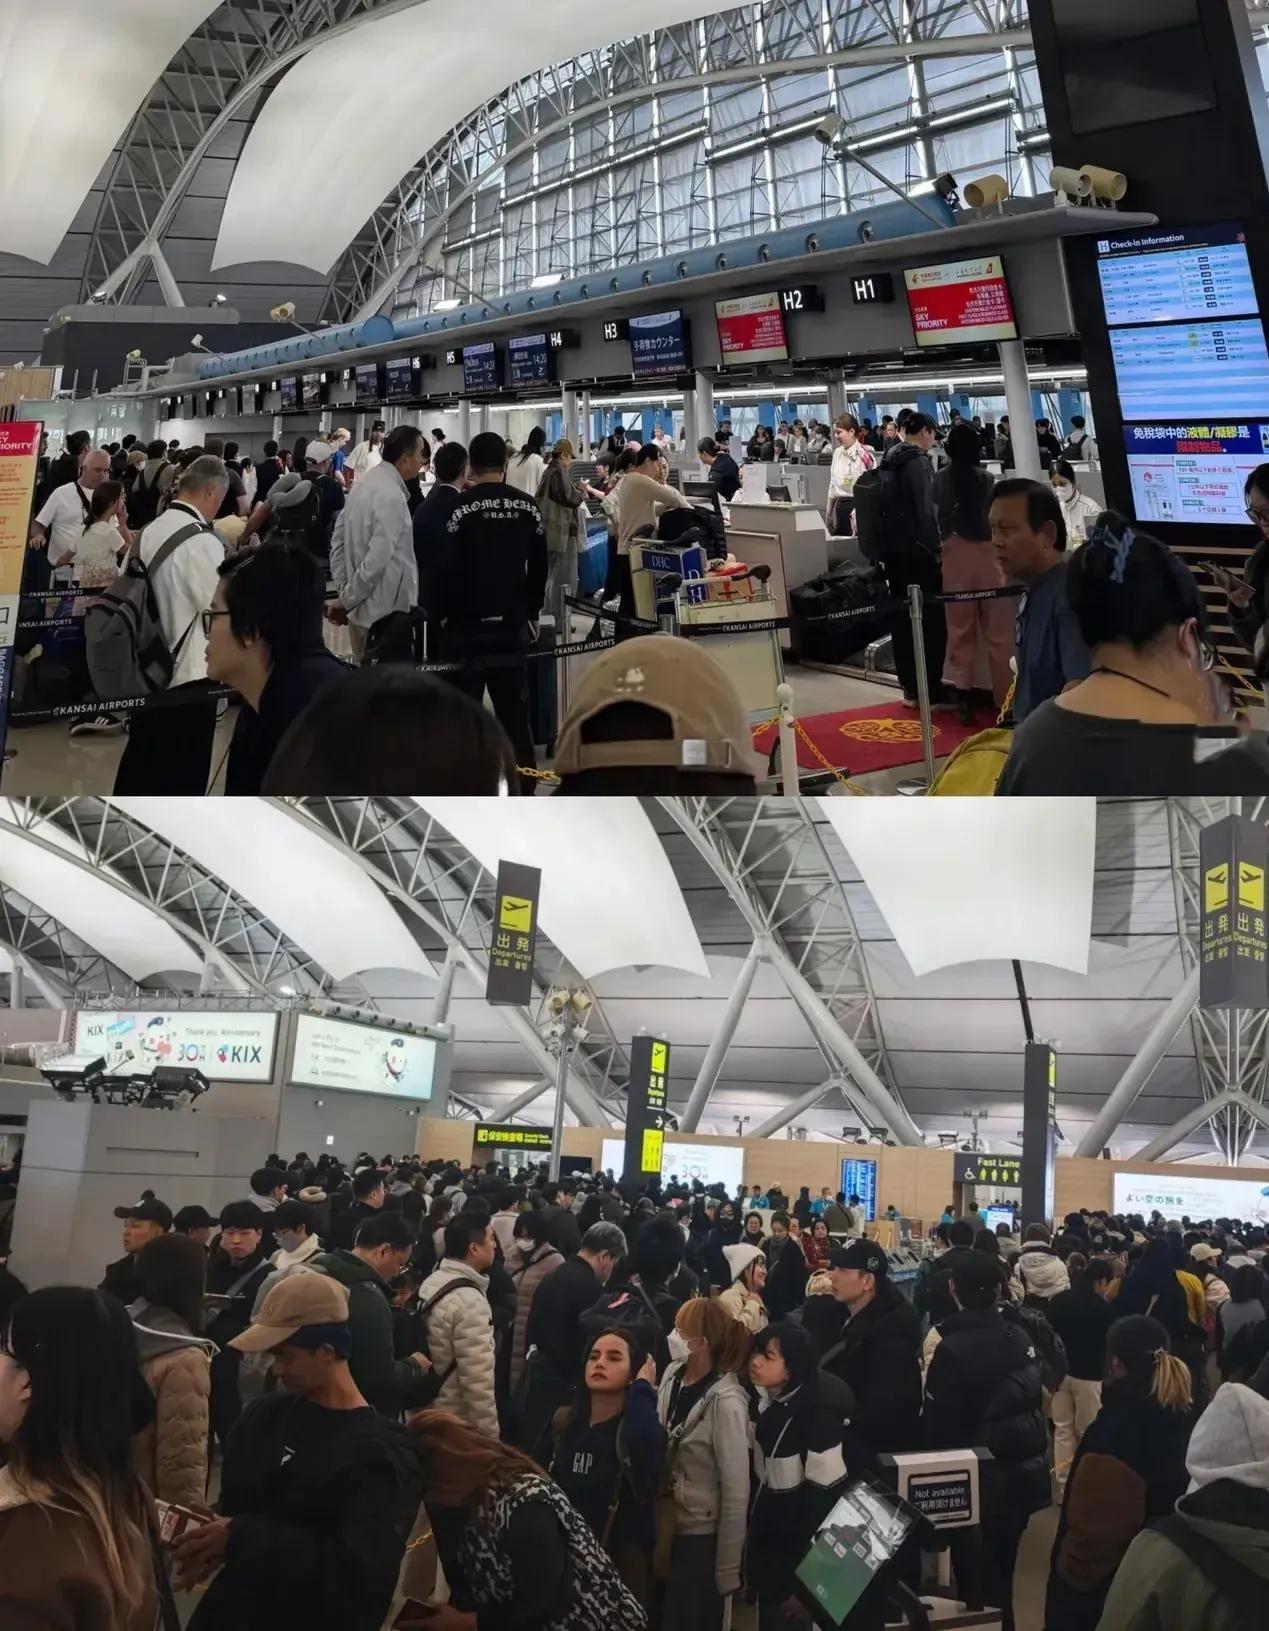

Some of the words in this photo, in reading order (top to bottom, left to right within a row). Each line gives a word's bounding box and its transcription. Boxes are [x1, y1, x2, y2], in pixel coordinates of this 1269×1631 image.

[1110, 239, 1140, 250] Check-in
[1141, 233, 1185, 246] Information
[854, 278, 875, 300] H1
[783, 290, 804, 310] H2
[915, 313, 929, 321] SKY
[917, 318, 948, 329] PRIORITY
[551, 331, 562, 347] H4
[604, 322, 618, 339] H3
[651, 555, 671, 569] DHC
[55, 589, 84, 597] AIRPORTS
[38, 618, 73, 628] AIRPORTS
[726, 623, 748, 632] KANSAI
[748, 620, 776, 630] AIRPORTS
[558, 643, 584, 655] KANSAI
[584, 638, 616, 651] AIRPORTS
[60, 704, 97, 716] KANSAI
[99, 698, 146, 712] AIRPORTS
[1204, 913, 1230, 938] 出発
[1237, 911, 1265, 937] 出発
[496, 933, 530, 952] 出発
[1203, 933, 1233, 951] Departures
[1233, 931, 1268, 950] Departures
[491, 947, 532, 962] Departures
[87, 1024, 104, 1037] KIX
[231, 1045, 262, 1064] KIX
[977, 1156, 998, 1167] Fast
[998, 1157, 1021, 1169] Lane
[1126, 1193, 1185, 1206] よい空の旅を
[572, 1452, 593, 1475] GAP
[914, 1489, 930, 1499] Not
[931, 1486, 966, 1497] available
